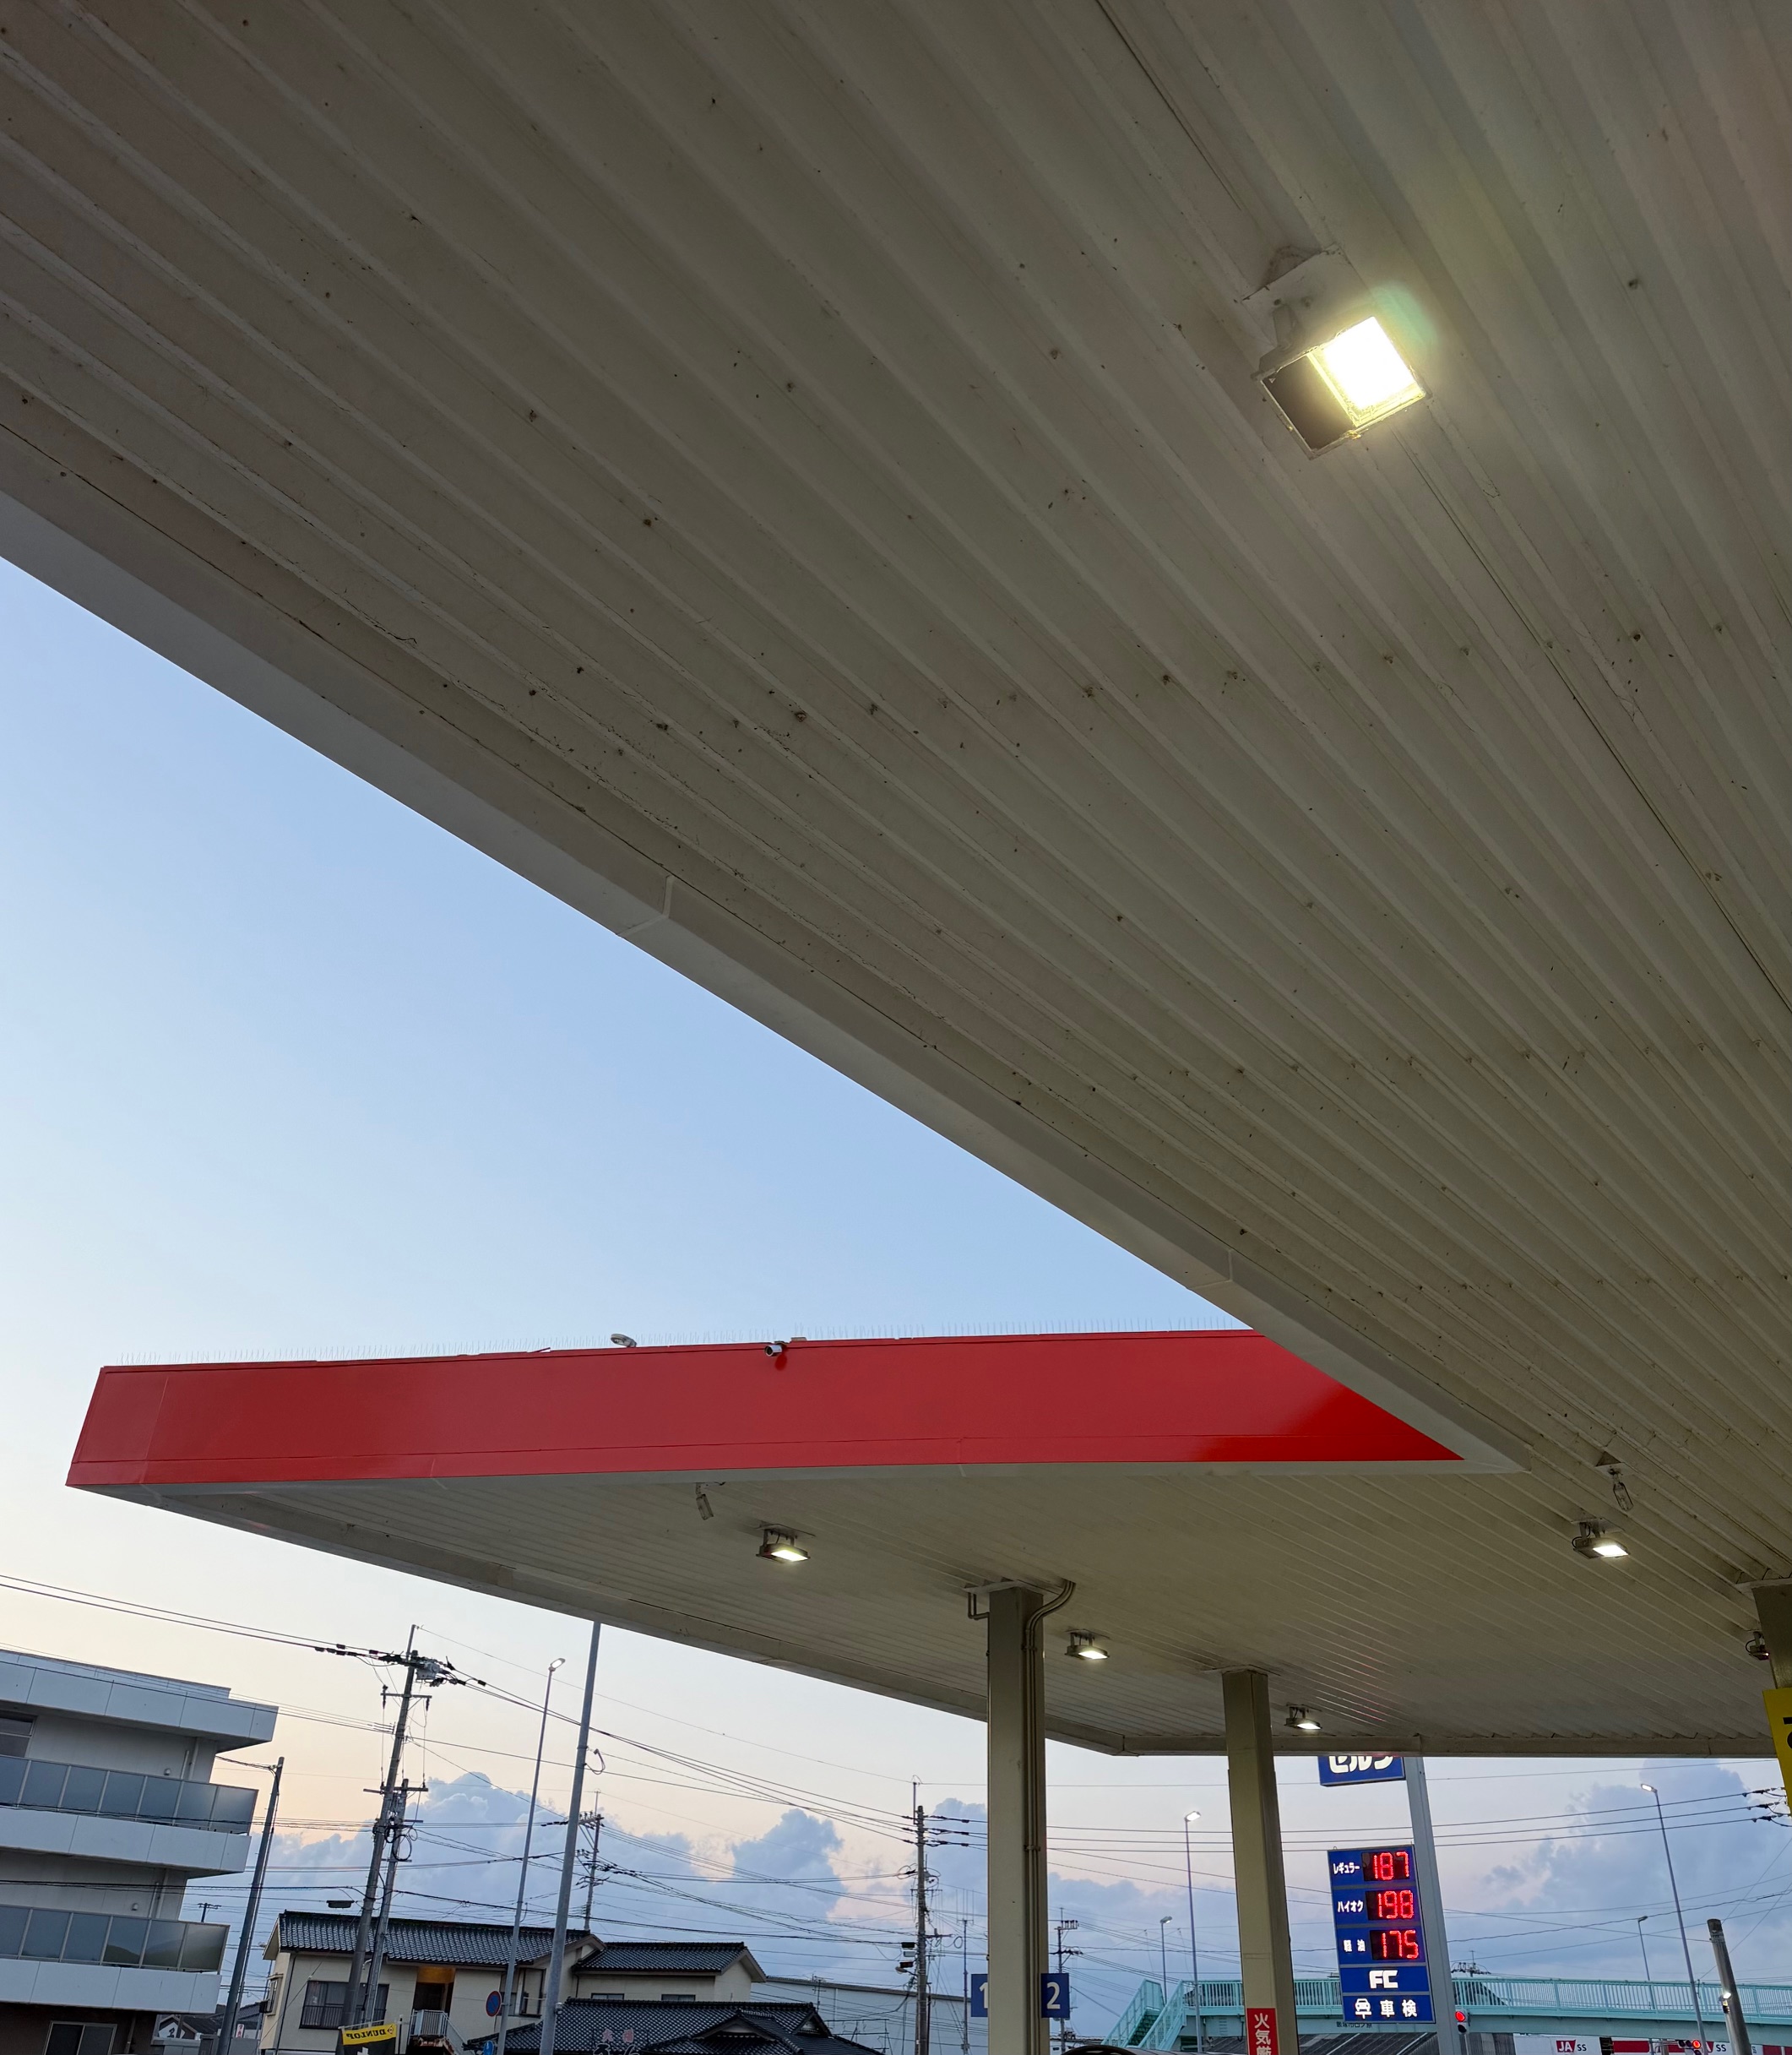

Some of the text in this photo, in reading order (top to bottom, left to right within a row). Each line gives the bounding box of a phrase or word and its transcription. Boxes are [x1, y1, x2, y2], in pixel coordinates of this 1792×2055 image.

[1333, 1851, 1409, 1881] レギュラー 187
[1337, 1889, 1415, 1919] ハイオク 198
[1382, 1929, 1419, 1959] 175
[1369, 1970, 1398, 1989] FC
[980, 1982, 989, 2009] 1
[1046, 1982, 1062, 2009] 2
[1379, 1998, 1419, 2018] 車検
[1558, 2041, 1588, 2052] JA SS
[1715, 2043, 1727, 2052] SS
